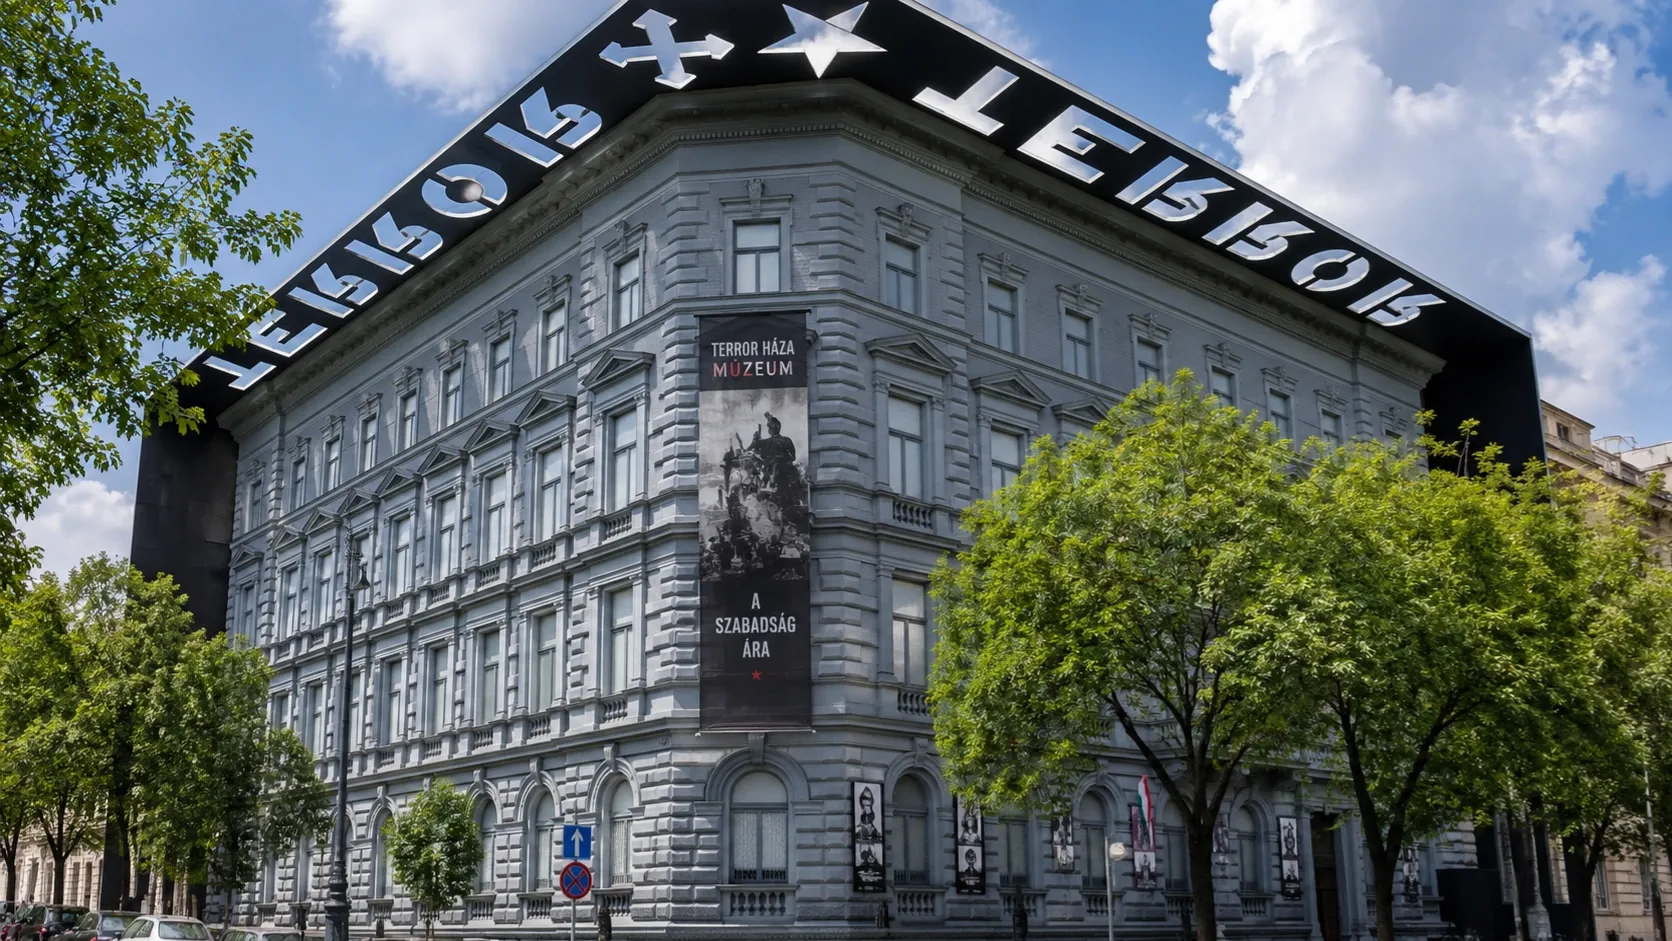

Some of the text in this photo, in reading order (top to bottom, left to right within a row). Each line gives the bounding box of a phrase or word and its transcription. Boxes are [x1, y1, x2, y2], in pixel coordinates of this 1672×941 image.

[711, 337, 795, 357] TERROR HÁZA
[713, 359, 793, 378] MÚZEUM
[751, 592, 761, 610] A
[715, 612, 797, 634] SZABADSÁG
[742, 638, 771, 658] ÁRA
